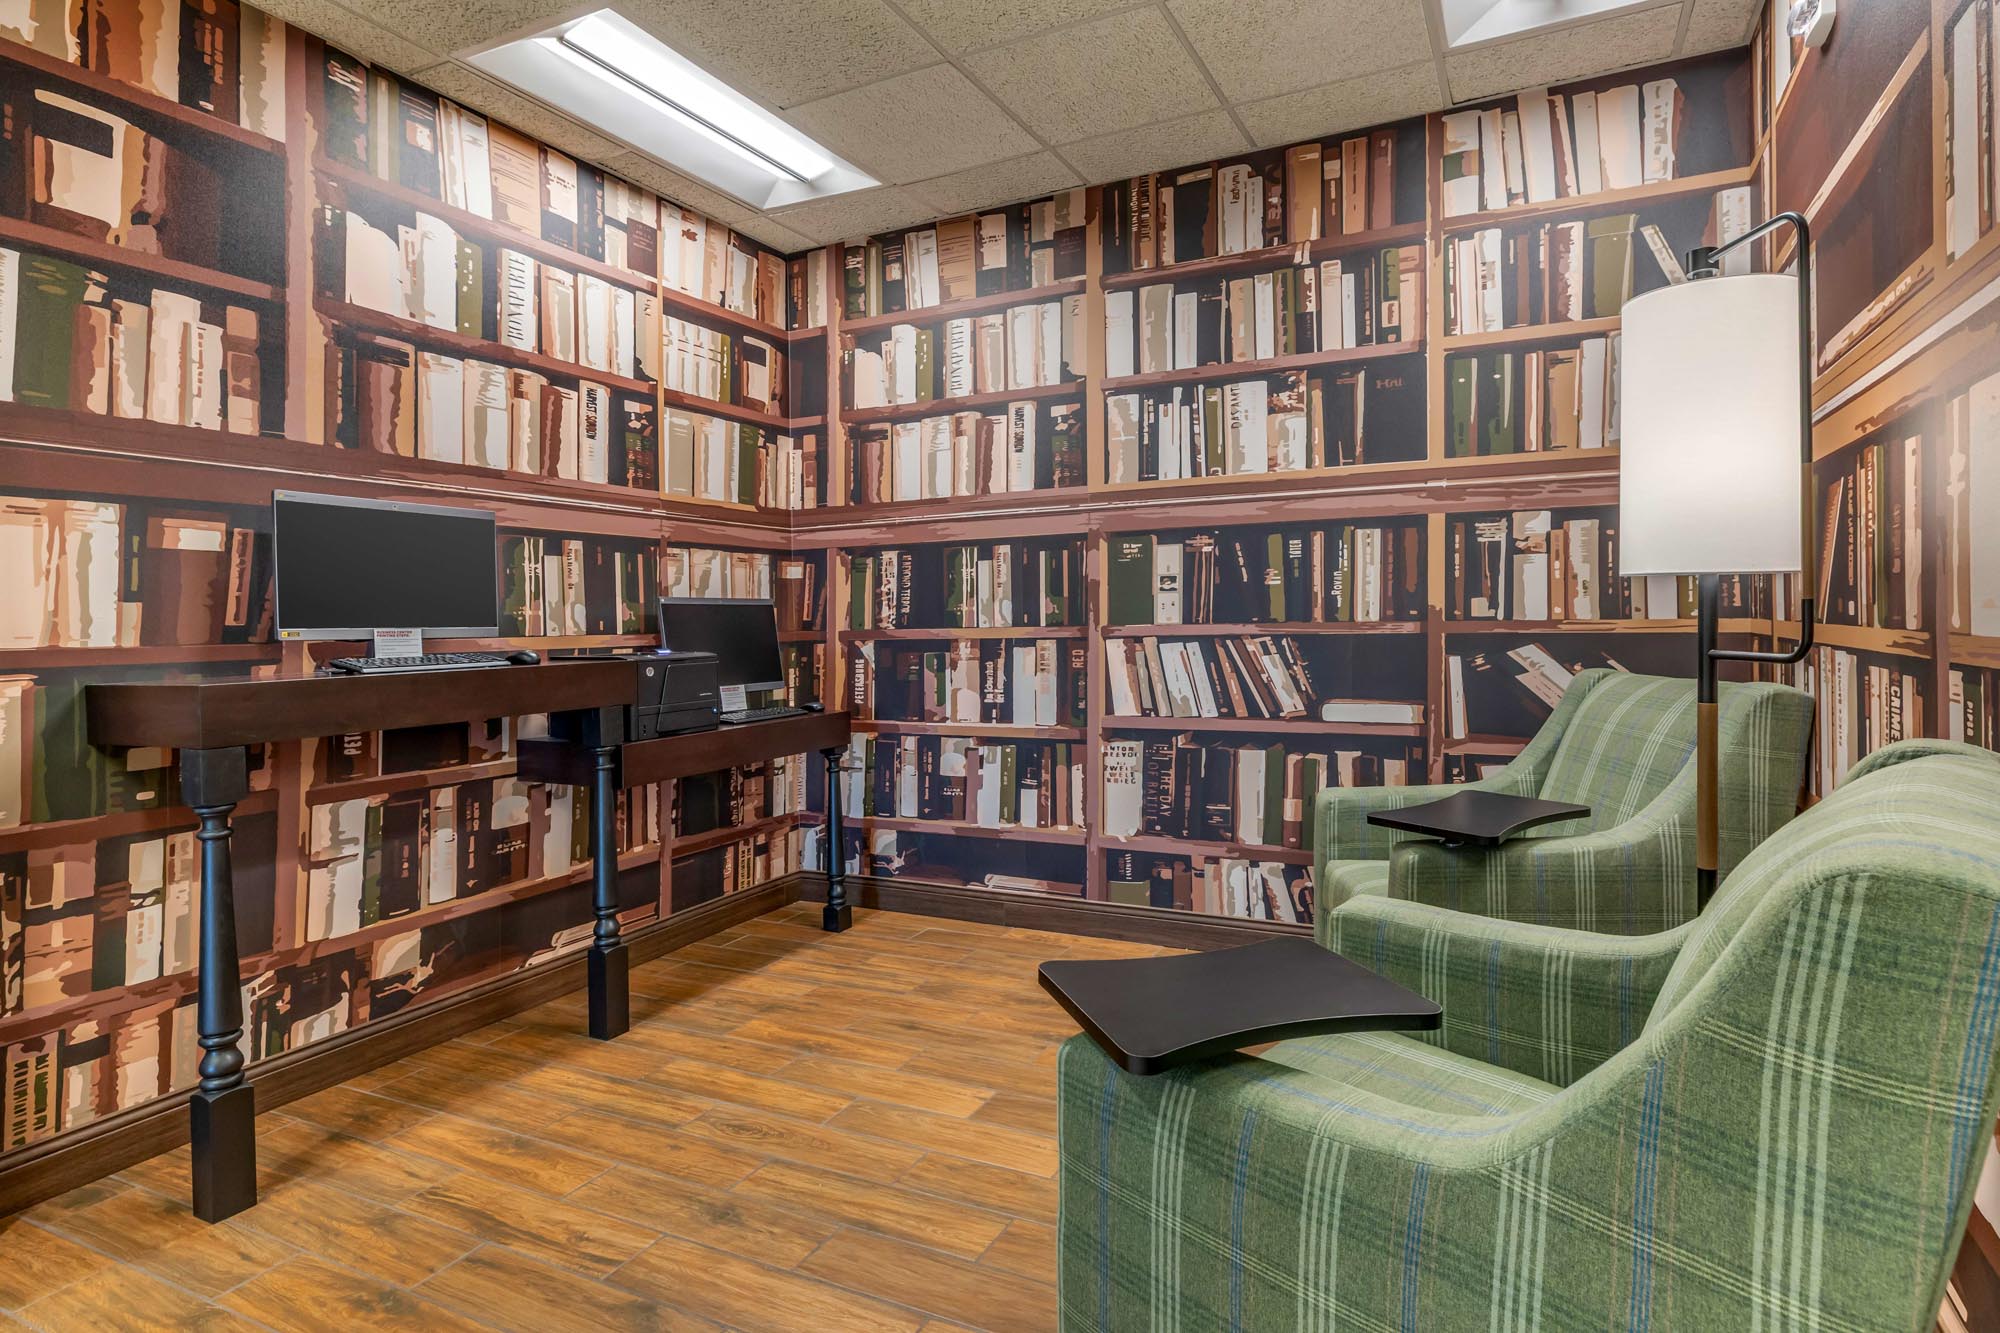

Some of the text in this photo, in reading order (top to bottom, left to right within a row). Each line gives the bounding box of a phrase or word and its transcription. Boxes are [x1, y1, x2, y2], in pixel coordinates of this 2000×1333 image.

[507, 254, 525, 341] BONAPARTE
[950, 320, 965, 391] BONAPARTE
[854, 658, 865, 704] PETERSBURG
[1072, 649, 1084, 668] RED
[1146, 762, 1159, 777] OF
[1159, 769, 1171, 817] THE DAY
